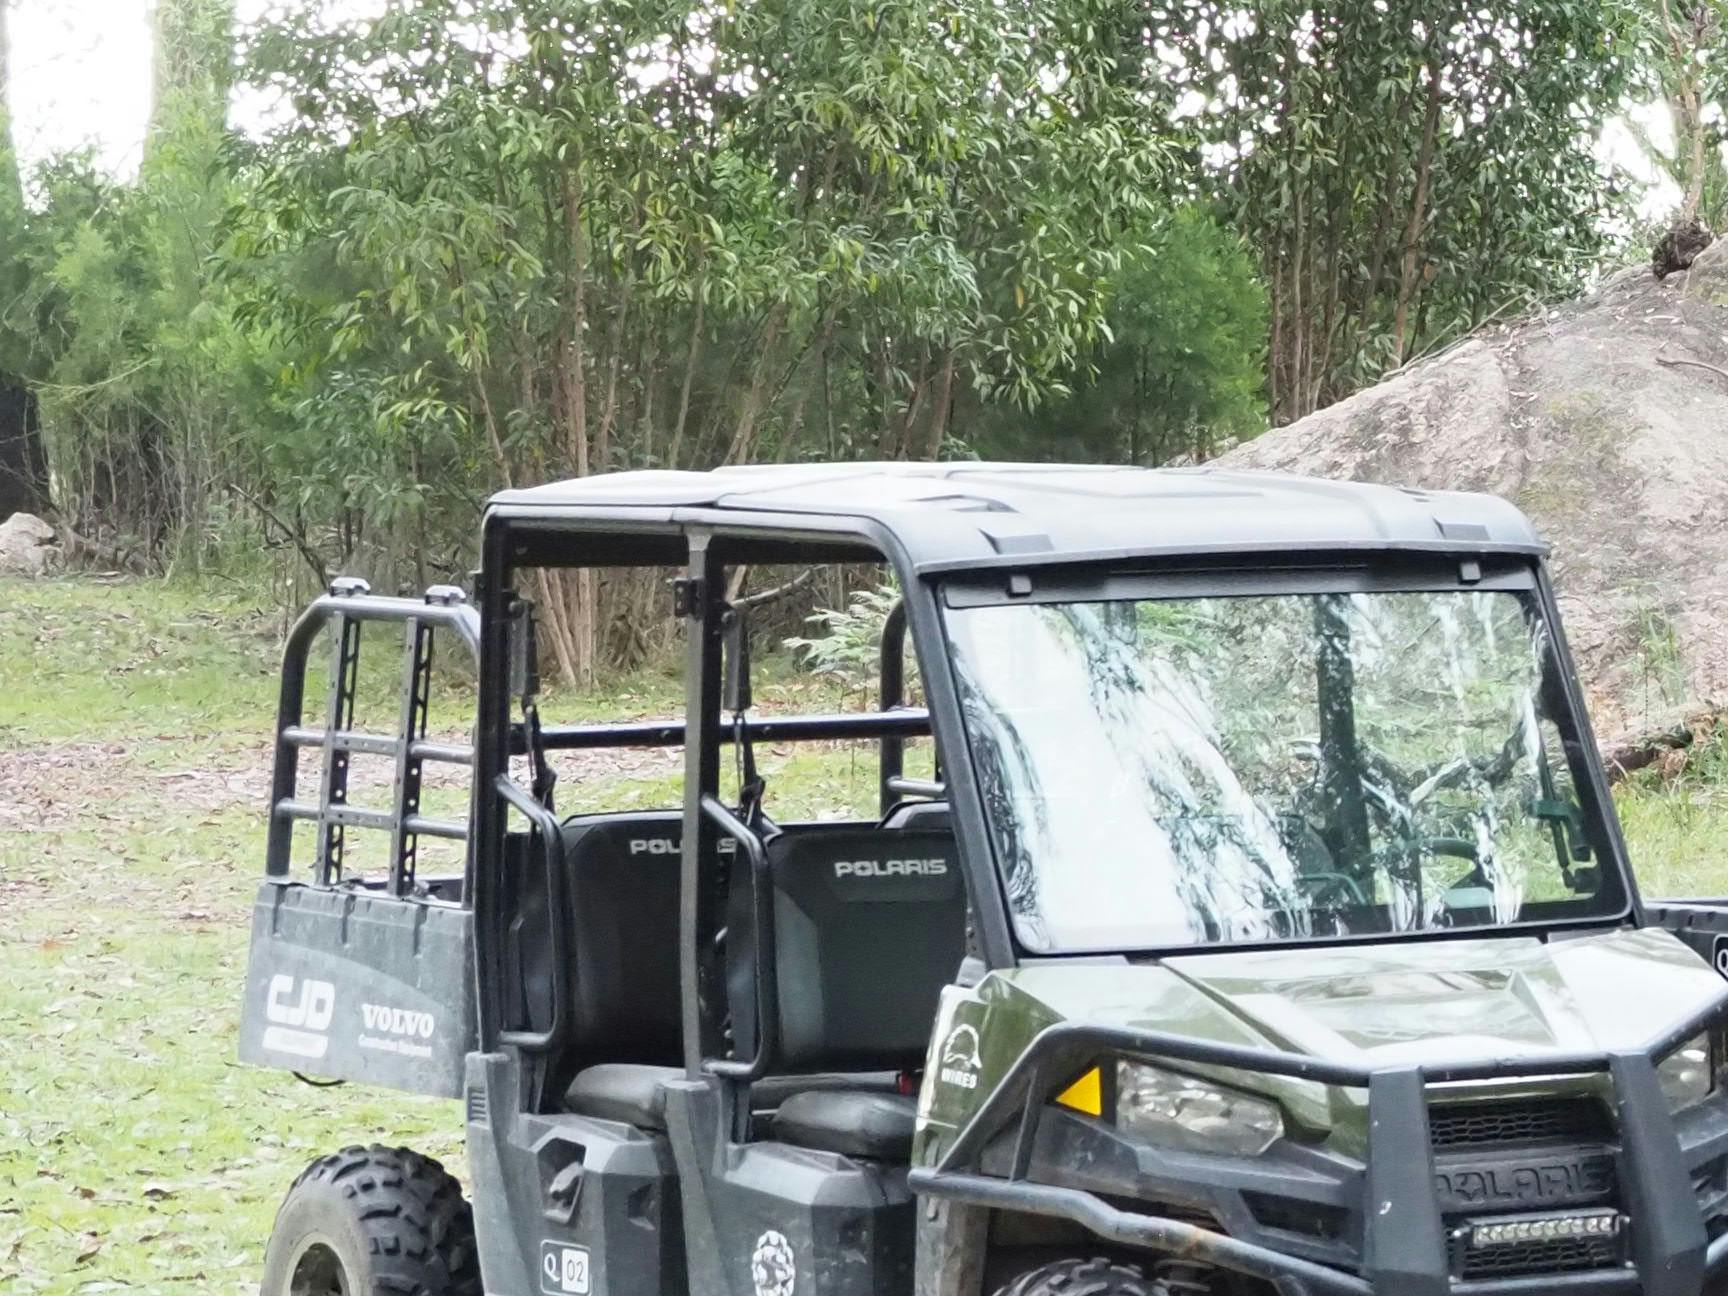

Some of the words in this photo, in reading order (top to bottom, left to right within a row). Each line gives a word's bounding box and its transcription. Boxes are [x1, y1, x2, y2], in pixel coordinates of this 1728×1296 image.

[630, 837, 737, 855] POLS
[834, 859, 948, 878] POLARIS
[267, 974, 335, 1031] CJD
[361, 1003, 434, 1038] VOLVO
[543, 1253, 561, 1282] Q
[566, 1259, 584, 1282] 02
